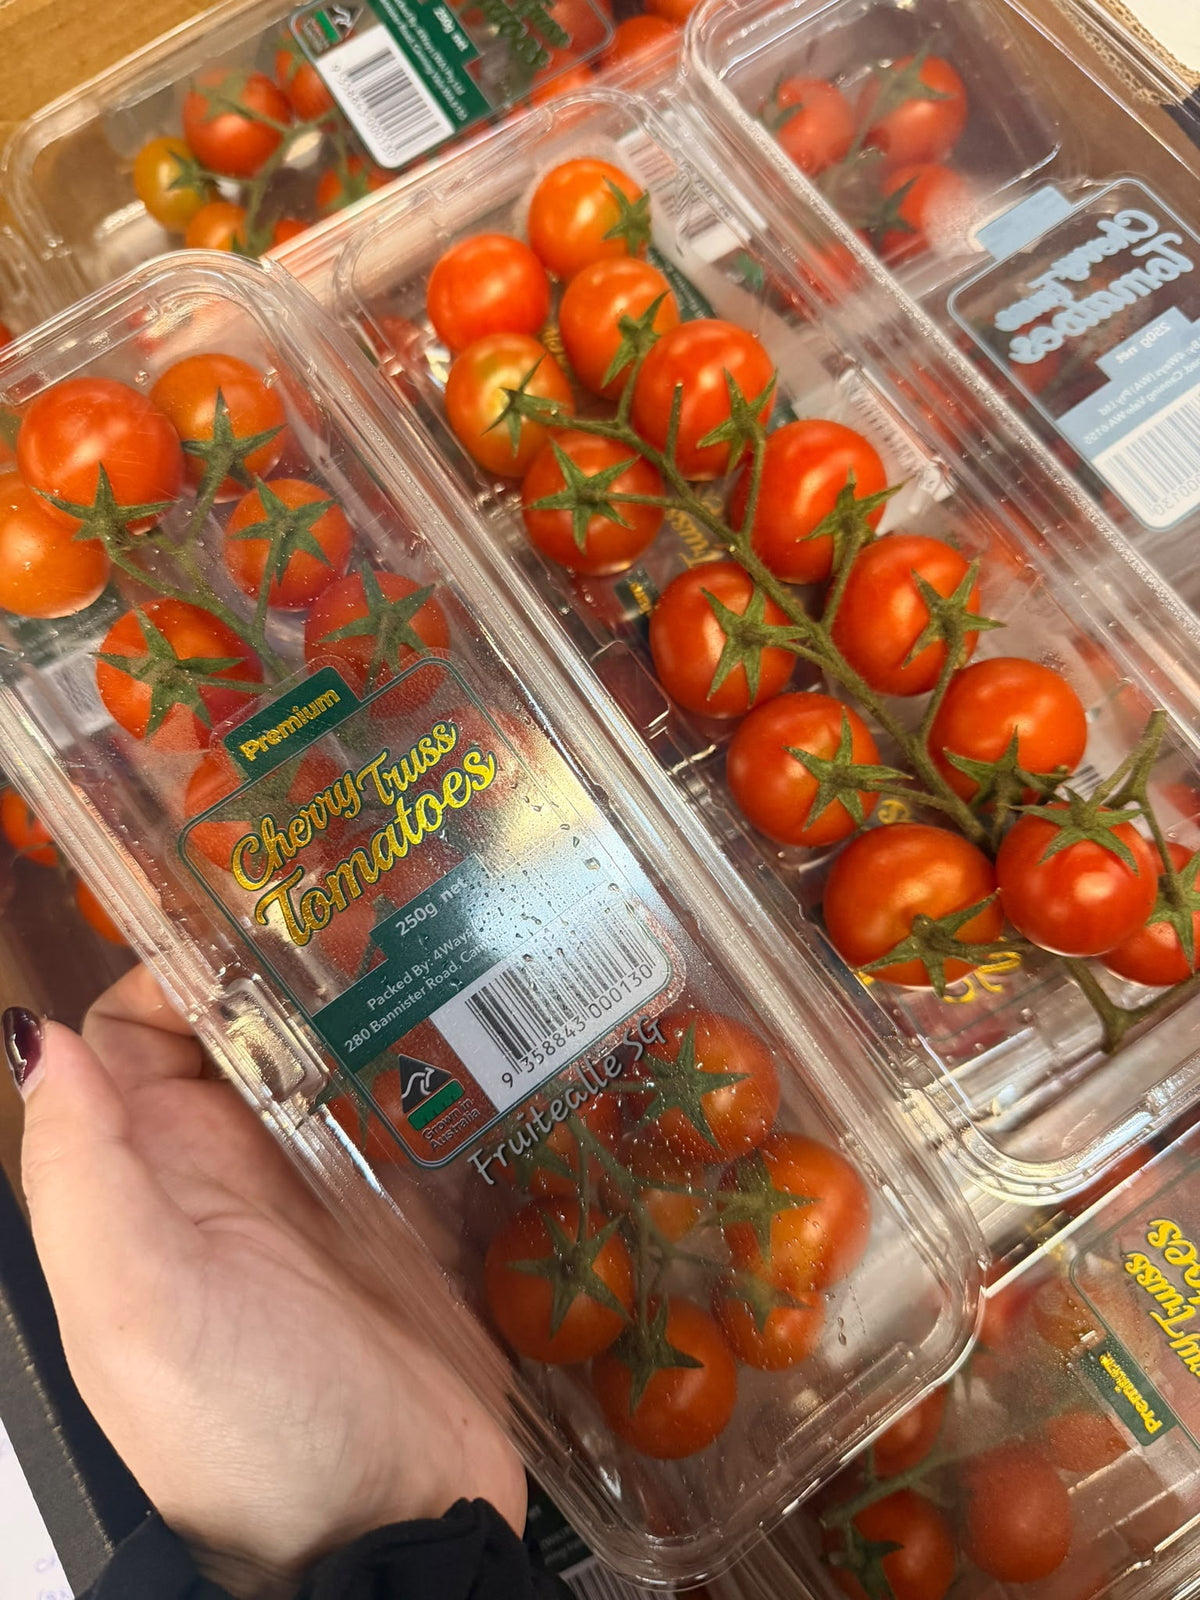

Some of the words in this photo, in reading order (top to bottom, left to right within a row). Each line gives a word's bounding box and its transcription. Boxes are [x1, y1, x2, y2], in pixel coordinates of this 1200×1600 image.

[238, 689, 341, 762] Premium
[230, 768, 362, 892] Cherry
[355, 720, 458, 807] Truss
[254, 748, 497, 947] Tomatoes
[395, 902, 439, 936] 250g
[344, 1028, 371, 1053] 280
[369, 985, 426, 1033] Bannister
[425, 960, 463, 991] Road,
[367, 972, 413, 1011] Packed
[411, 957, 434, 979] By:
[434, 927, 473, 960] 4Ways
[519, 1015, 587, 1073] 358843
[588, 963, 654, 1019] 000130
[421, 1104, 466, 1141] Grown
[457, 1095, 473, 1111] in
[430, 1107, 480, 1150] Australia
[1124, 1252, 1196, 1339] Truss
